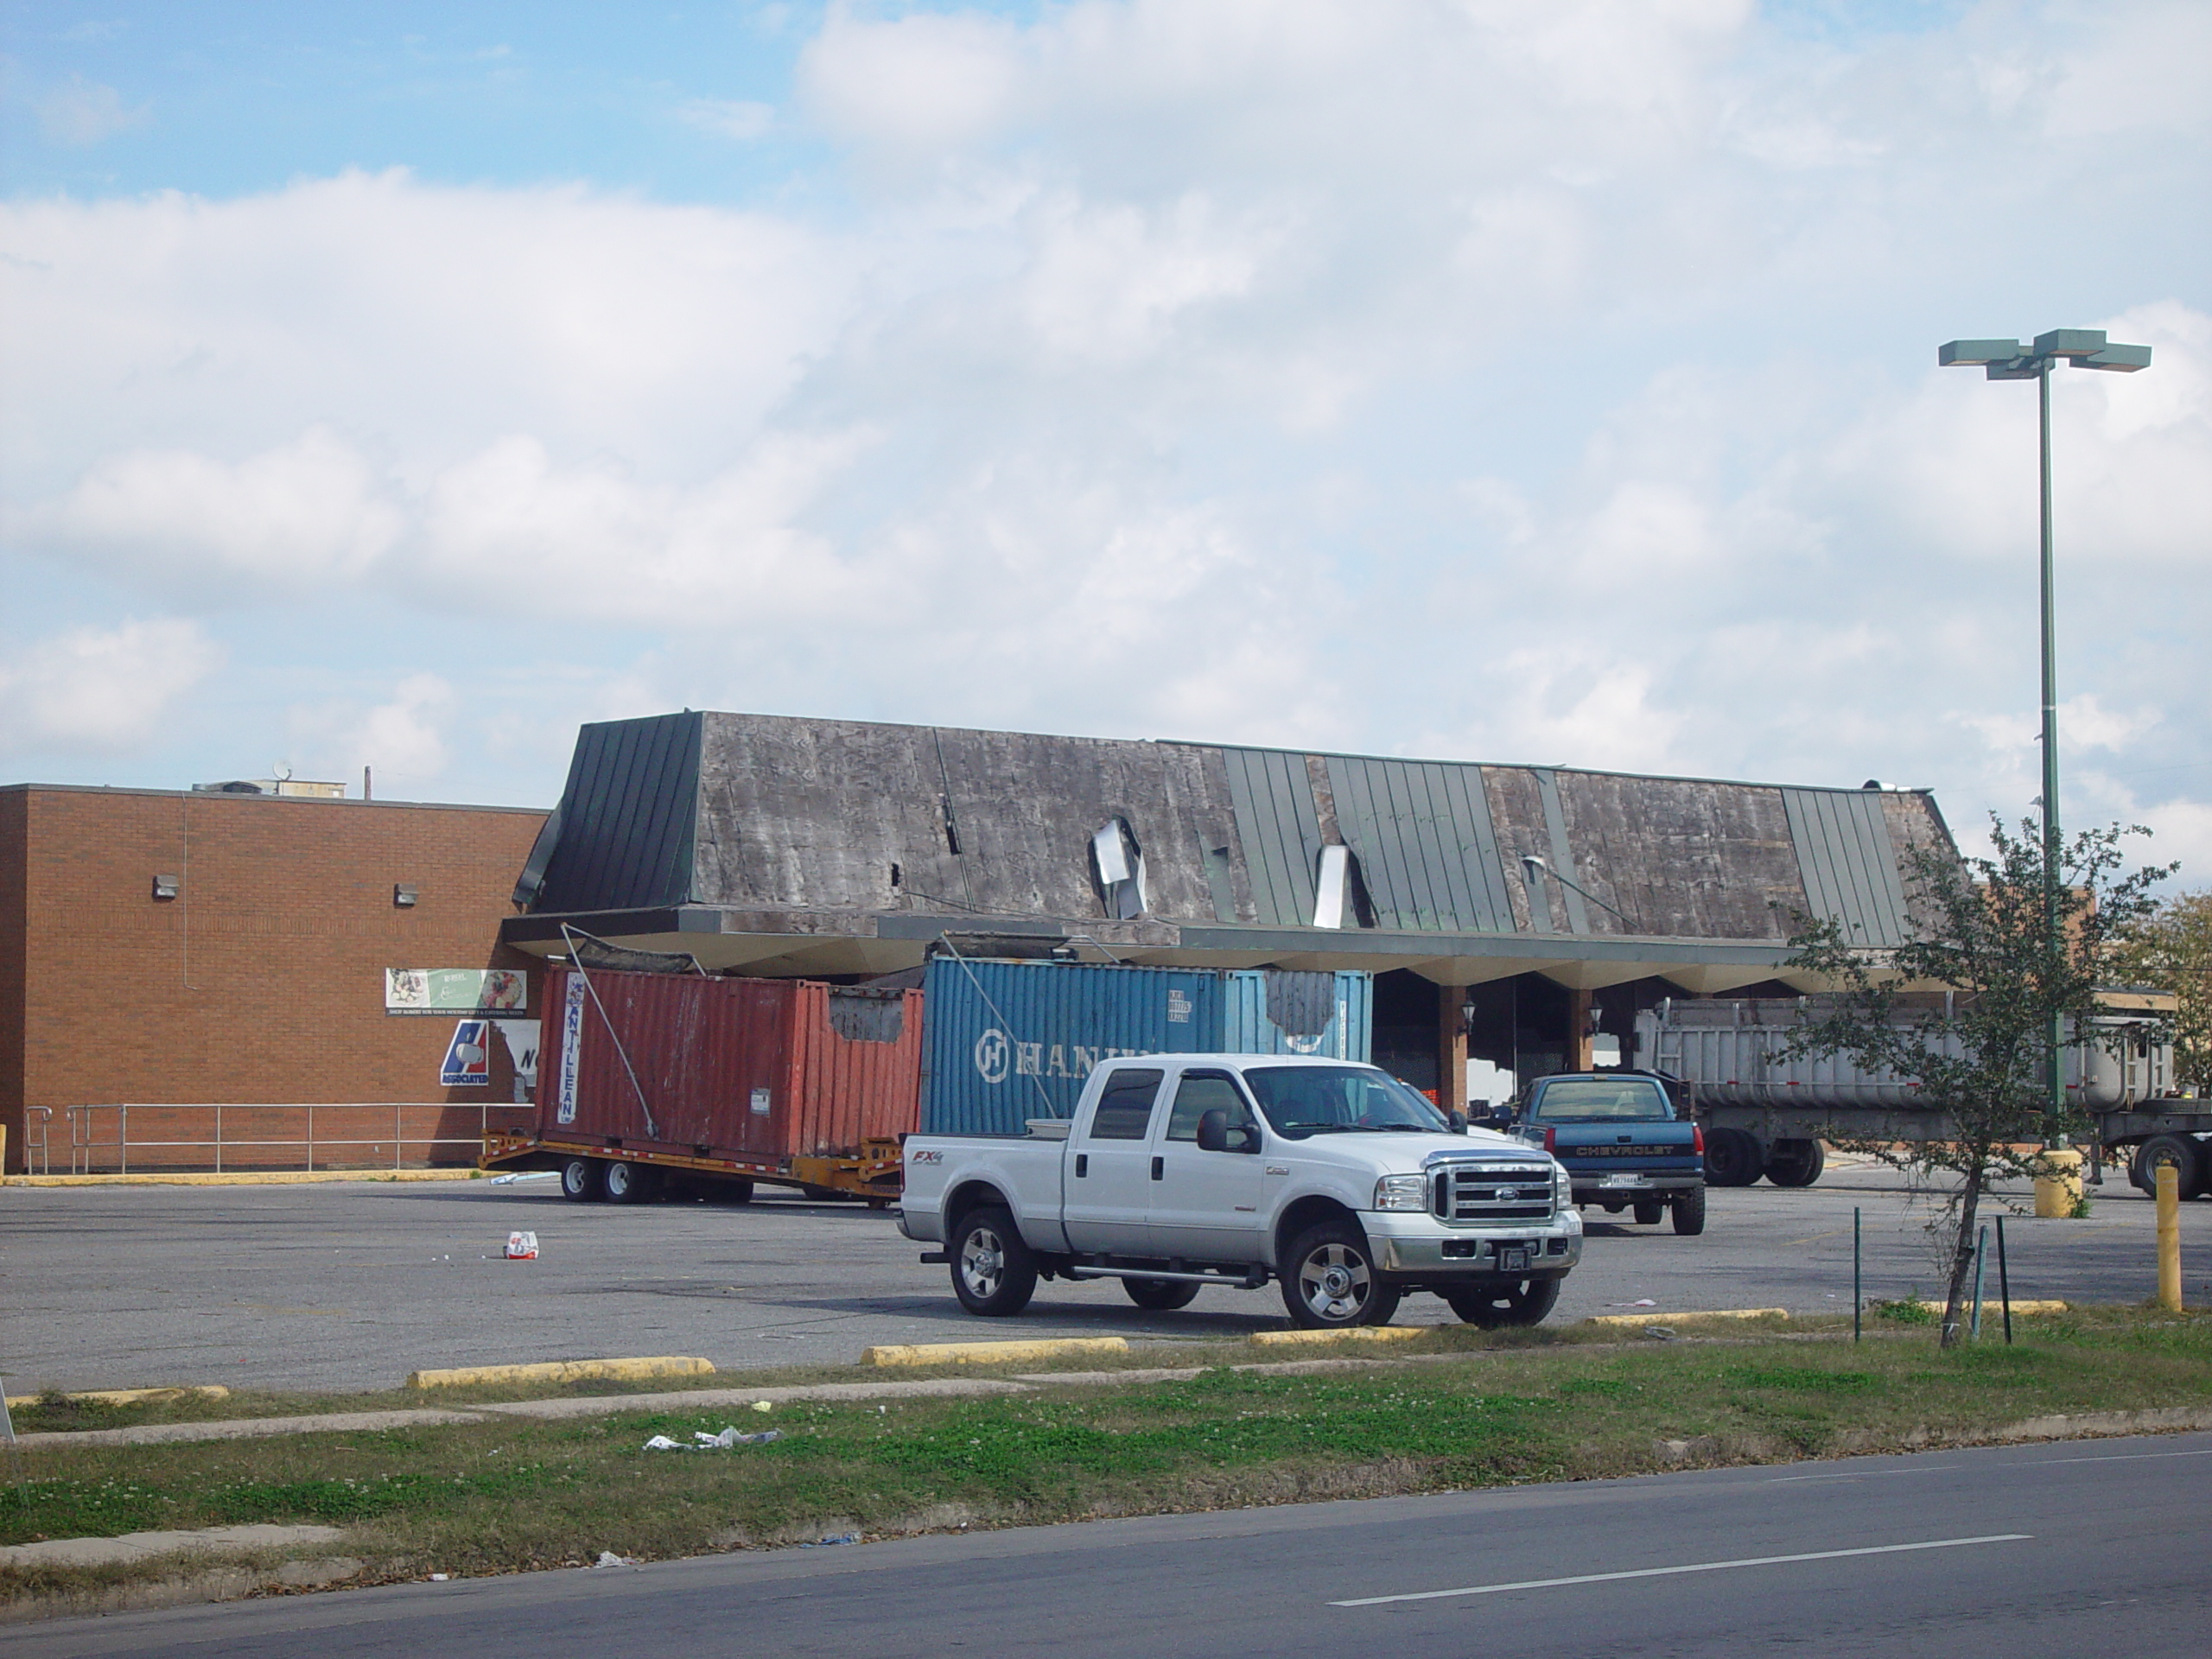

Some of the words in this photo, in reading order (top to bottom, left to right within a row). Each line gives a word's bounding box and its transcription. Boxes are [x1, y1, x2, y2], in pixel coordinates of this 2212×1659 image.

[563, 1006, 579, 1116] ANTILLEAN
[442, 1074, 489, 1084] ASSOCIATED
[912, 1150, 944, 1161] FX4
[1576, 1146, 1675, 1156] CHEVROLET
